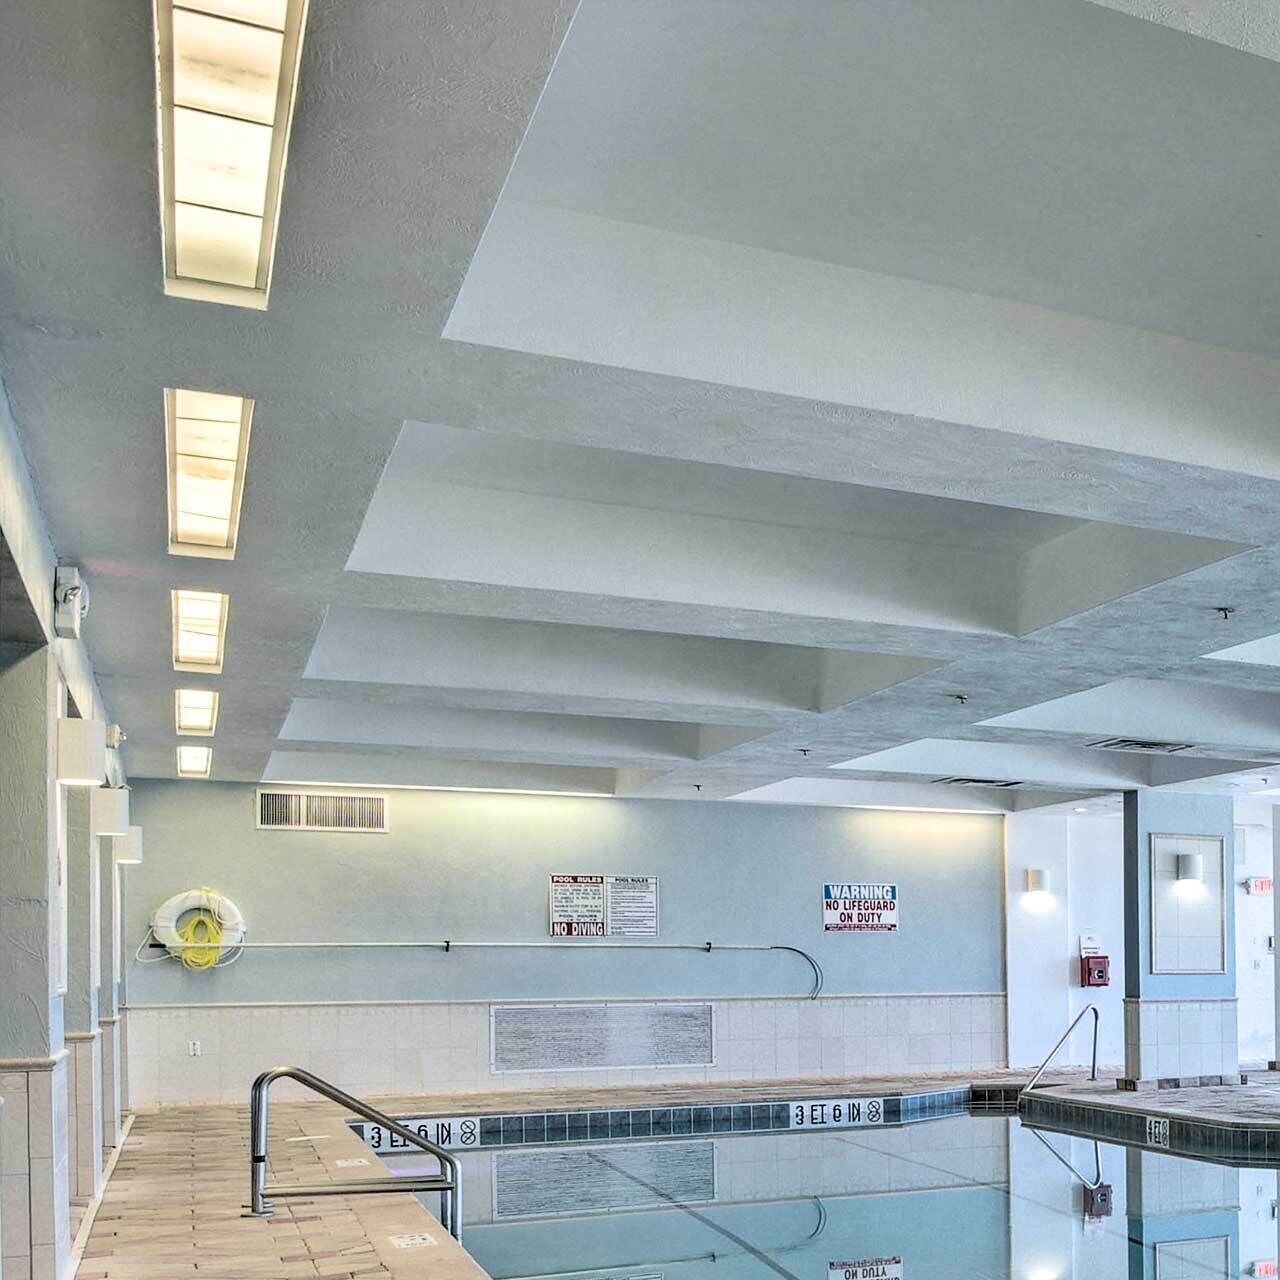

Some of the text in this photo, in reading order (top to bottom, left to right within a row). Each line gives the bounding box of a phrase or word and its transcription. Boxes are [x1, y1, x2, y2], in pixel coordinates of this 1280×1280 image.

[829, 885, 893, 899] WARNING
[1254, 879, 1272, 892] EXIT
[825, 900, 896, 911] NO LIFEGUARD
[839, 912, 883, 923] ON DUTY
[553, 922, 604, 936] NO DIVING
